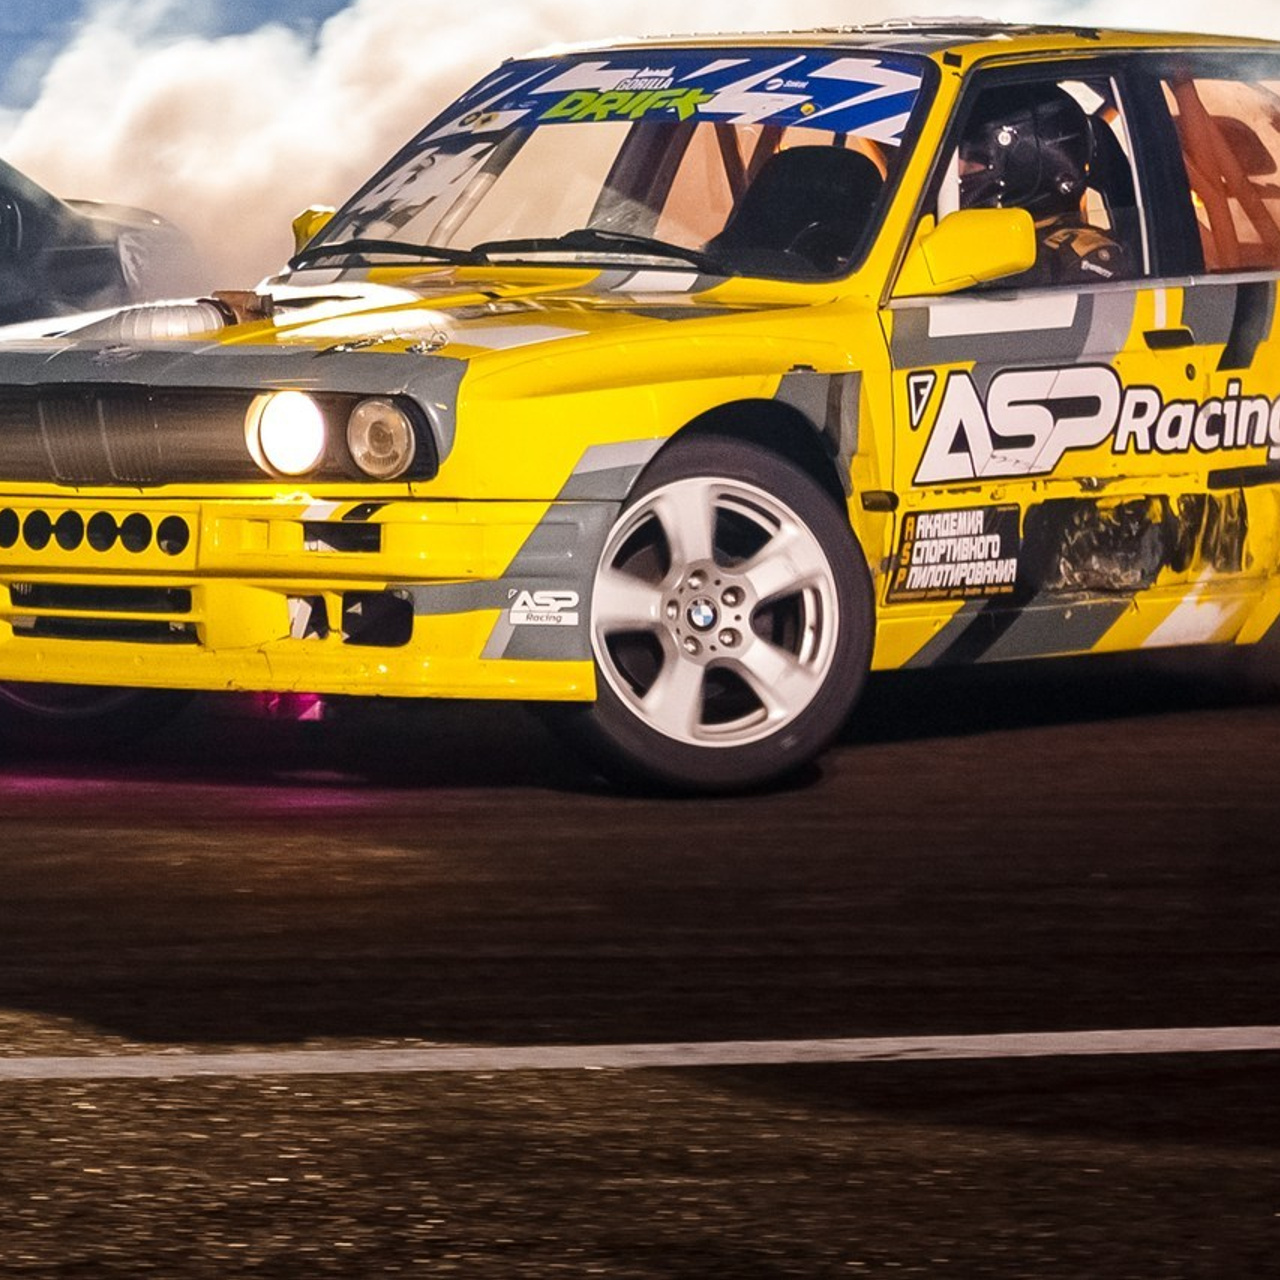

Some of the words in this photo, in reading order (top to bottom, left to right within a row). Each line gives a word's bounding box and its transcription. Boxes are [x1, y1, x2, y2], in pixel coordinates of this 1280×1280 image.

[616, 76, 675, 91] GORILLA
[536, 87, 715, 122] DRIFT
[913, 365, 1122, 484] ASP
[916, 510, 984, 540] АКАДЕМИЯ
[912, 534, 1001, 565] СПОРТИВНОГО
[510, 590, 580, 612] ASP
[525, 613, 563, 623] Racing
